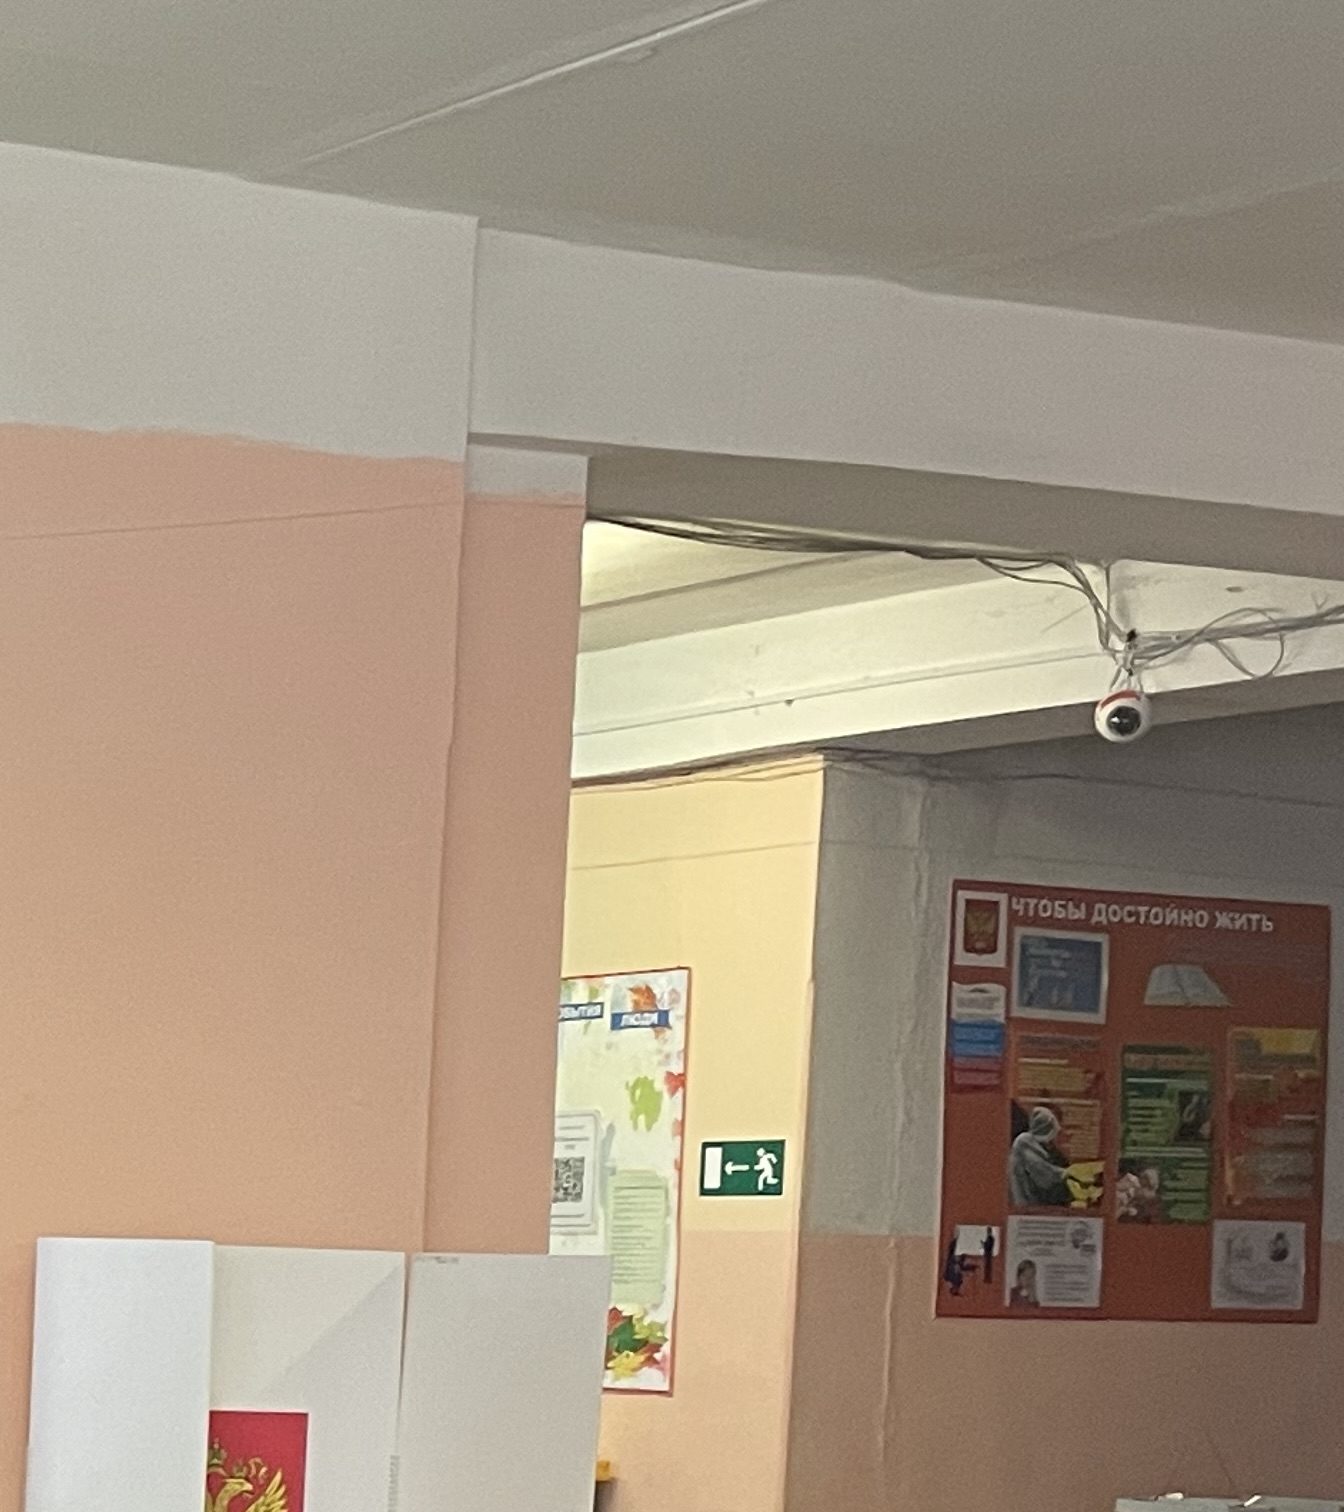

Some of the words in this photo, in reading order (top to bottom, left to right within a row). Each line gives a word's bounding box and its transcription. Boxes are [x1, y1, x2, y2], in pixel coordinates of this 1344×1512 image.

[1011, 895, 1087, 921] ЧТОБЫ
[1090, 900, 1210, 929] ДОСТОЙНО
[1214, 911, 1274, 933] ЖИТЬ
